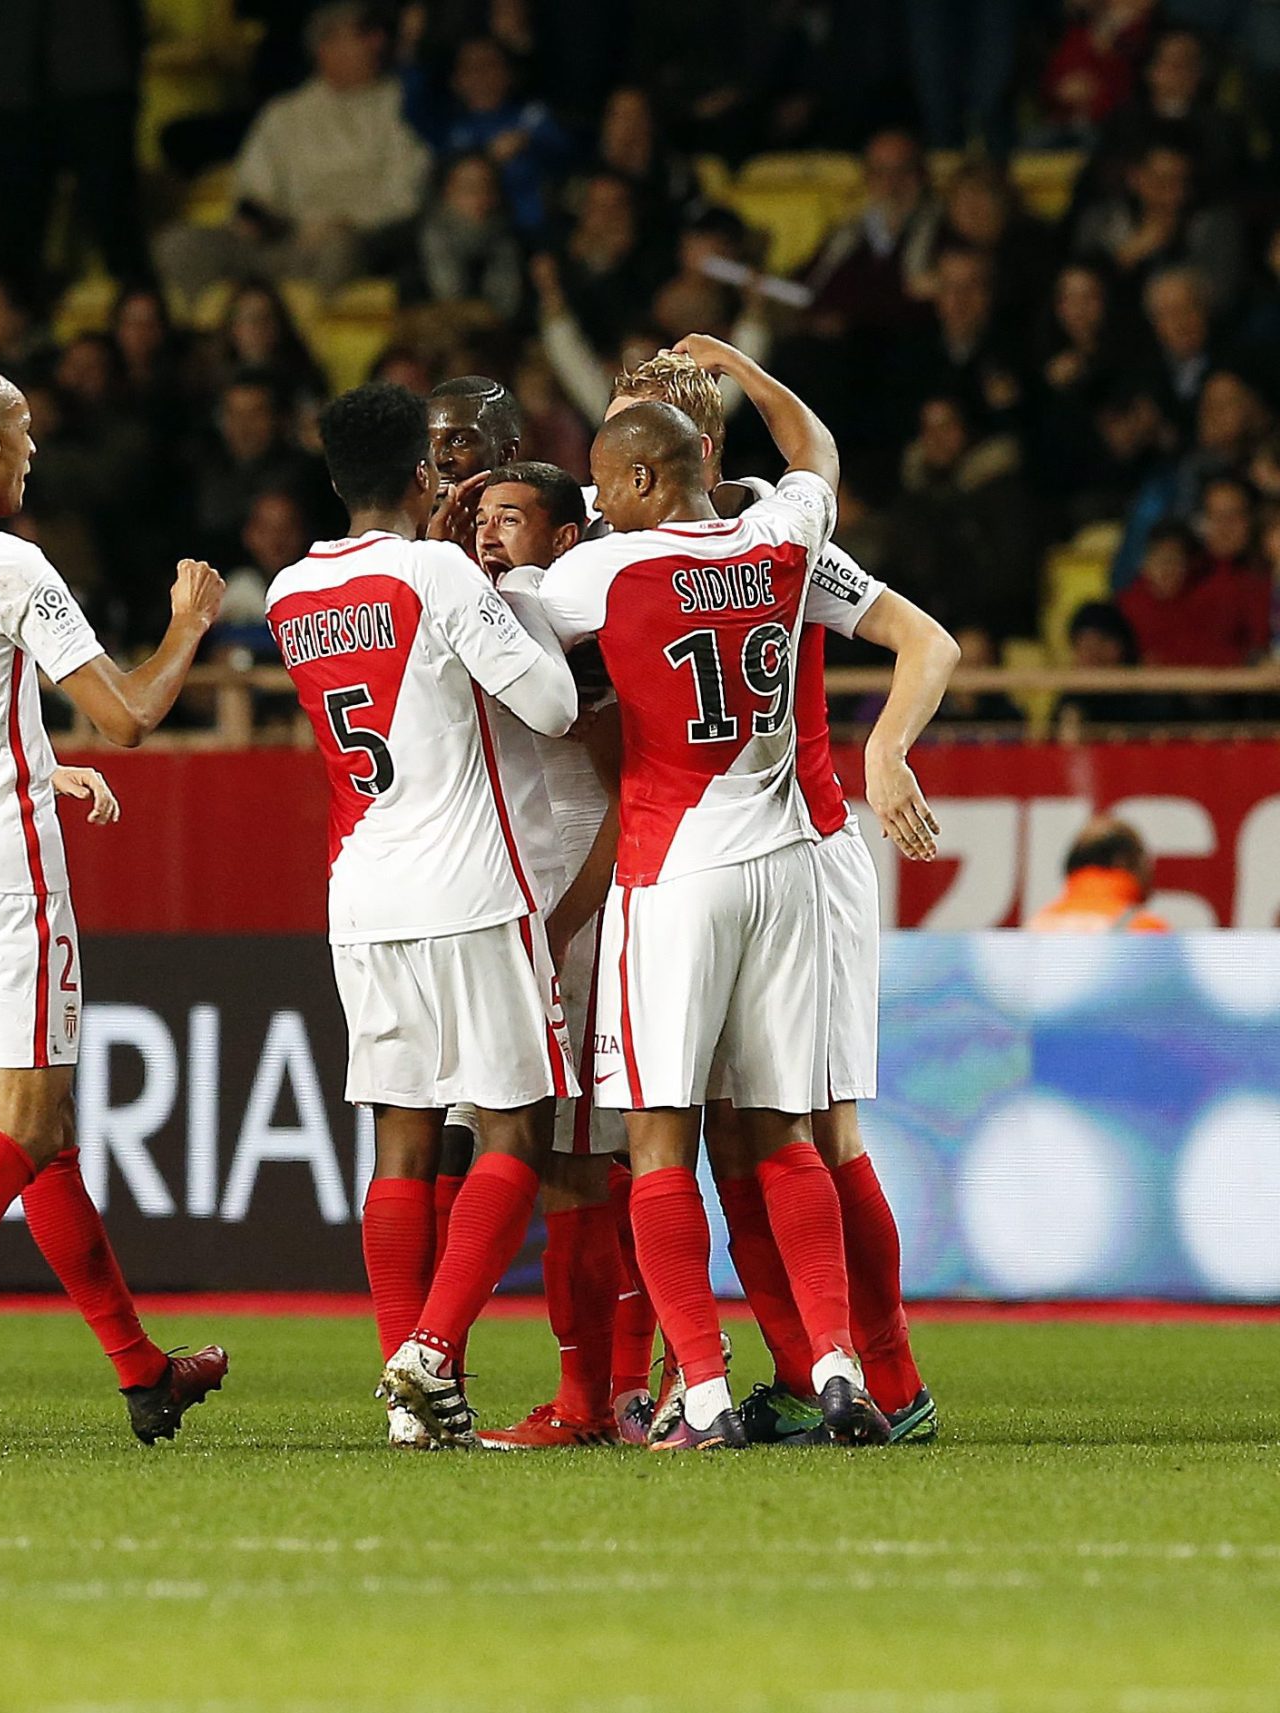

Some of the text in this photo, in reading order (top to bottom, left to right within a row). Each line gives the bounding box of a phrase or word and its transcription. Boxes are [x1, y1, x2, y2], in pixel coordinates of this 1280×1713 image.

[672, 560, 776, 613] SIDIBE
[663, 622, 793, 744] 19
[322, 682, 398, 798] 5
[55, 935, 78, 992] 2
